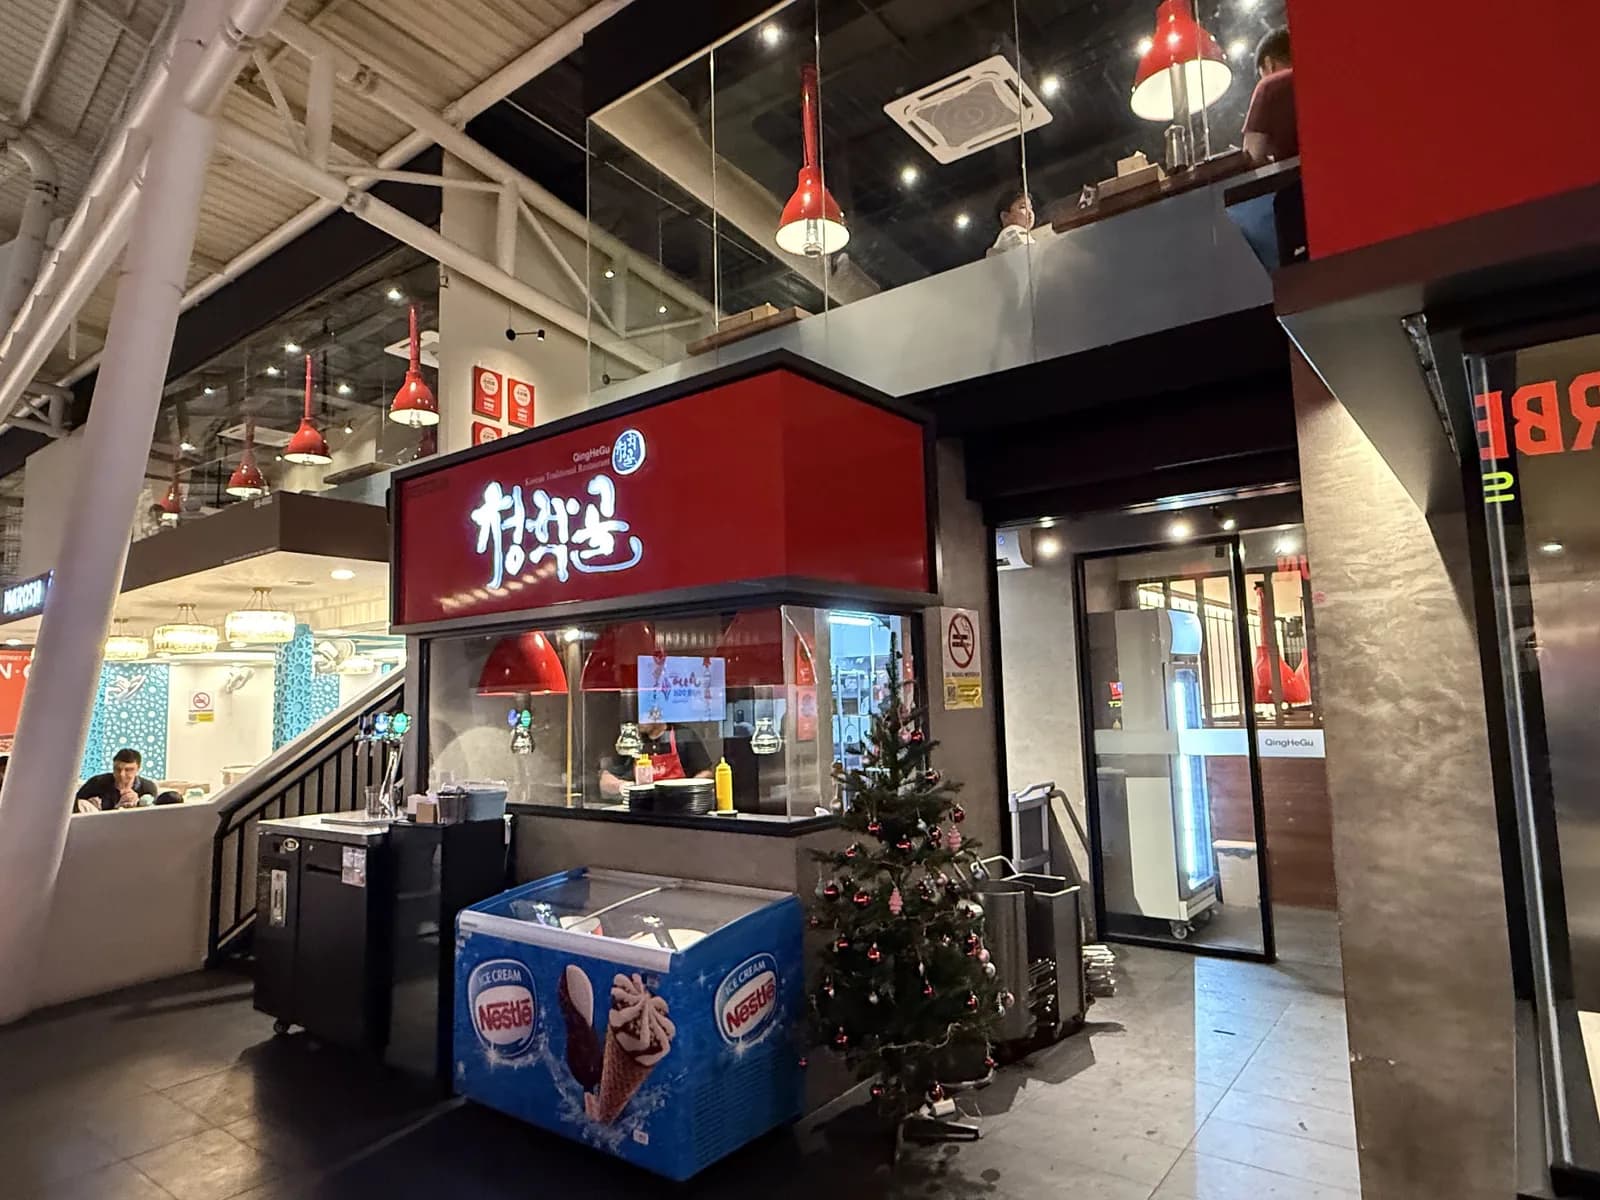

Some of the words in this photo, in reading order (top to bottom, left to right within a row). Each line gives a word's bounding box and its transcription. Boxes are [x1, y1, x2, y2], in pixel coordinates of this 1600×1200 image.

[572, 445, 610, 462] QingHeGu
[1264, 738, 1314, 748] QingHeGu
[478, 971, 491, 987] ICE
[492, 968, 522, 982] CREAM
[724, 981, 739, 996] ICE
[739, 960, 766, 983] CREAM
